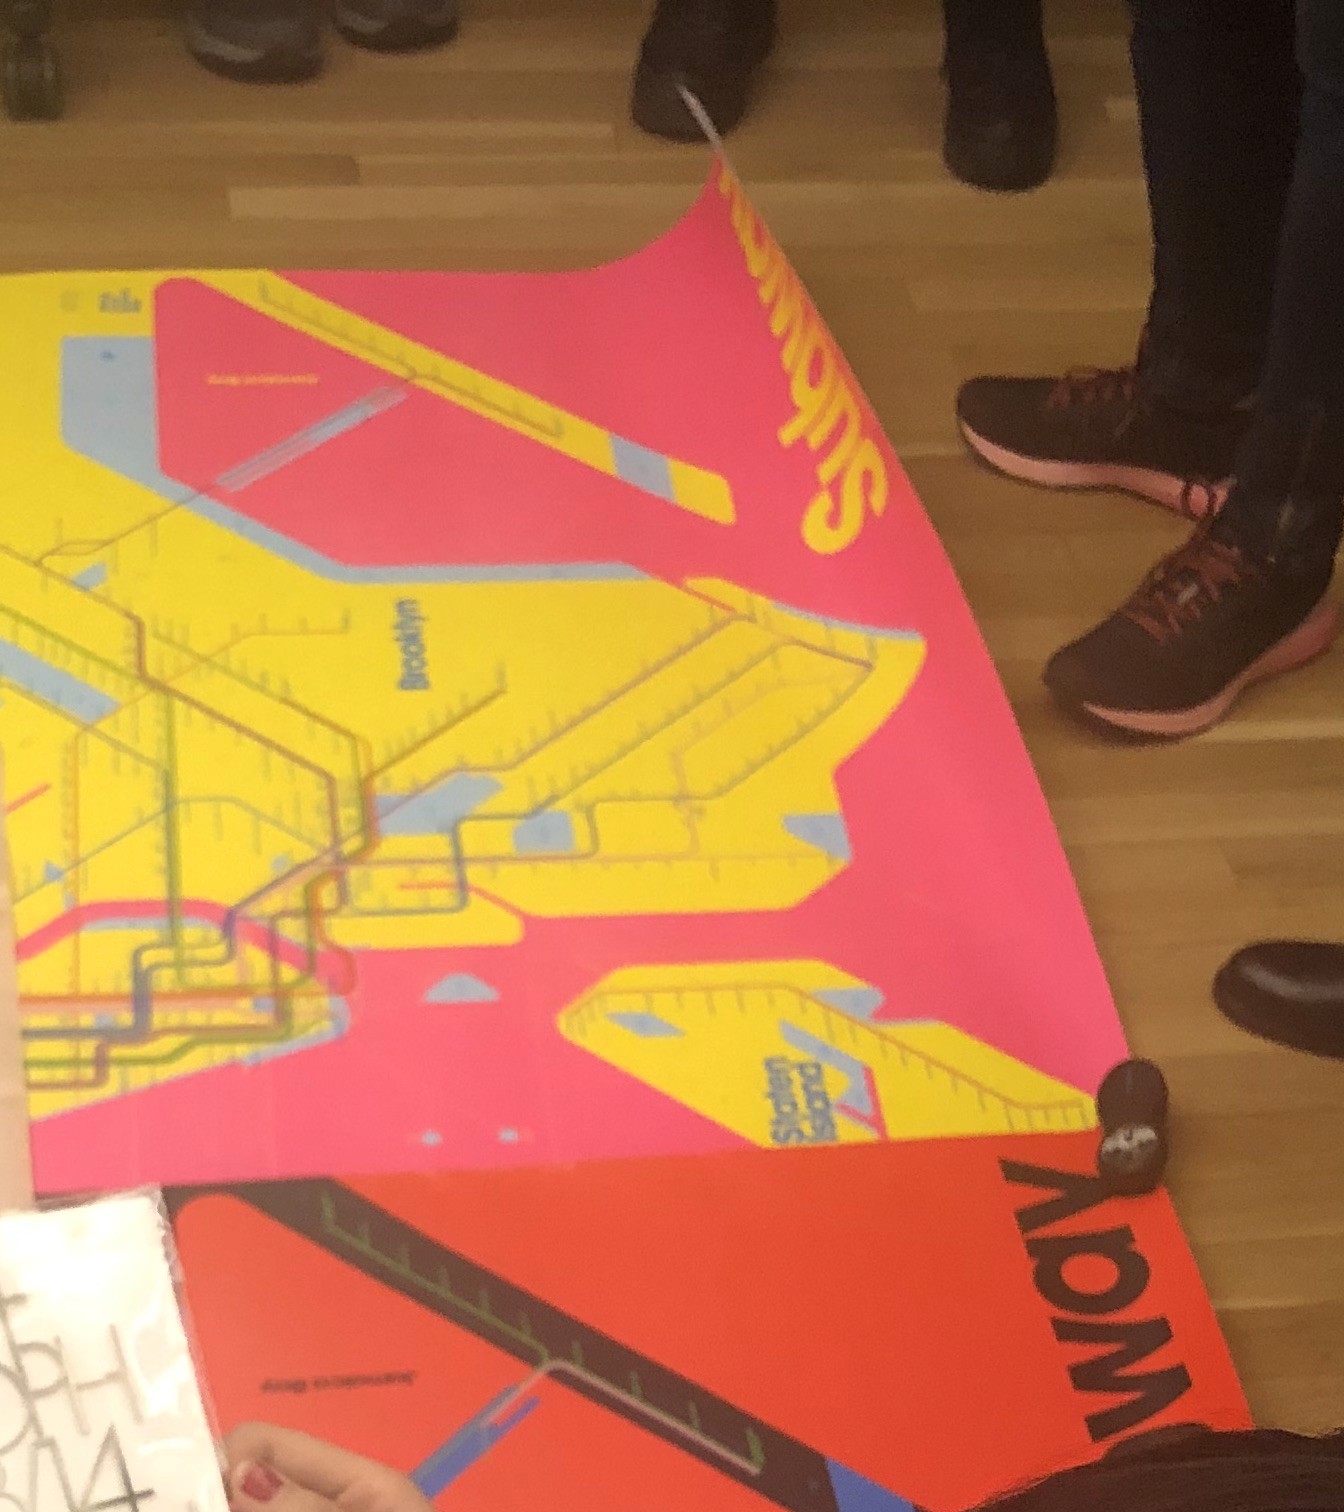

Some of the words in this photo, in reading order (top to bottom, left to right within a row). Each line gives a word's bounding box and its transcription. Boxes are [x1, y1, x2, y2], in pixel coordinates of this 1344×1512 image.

[393, 597, 429, 693] Brooklyn
[762, 1056, 806, 1145] Staten
[793, 1062, 838, 1144] Island
